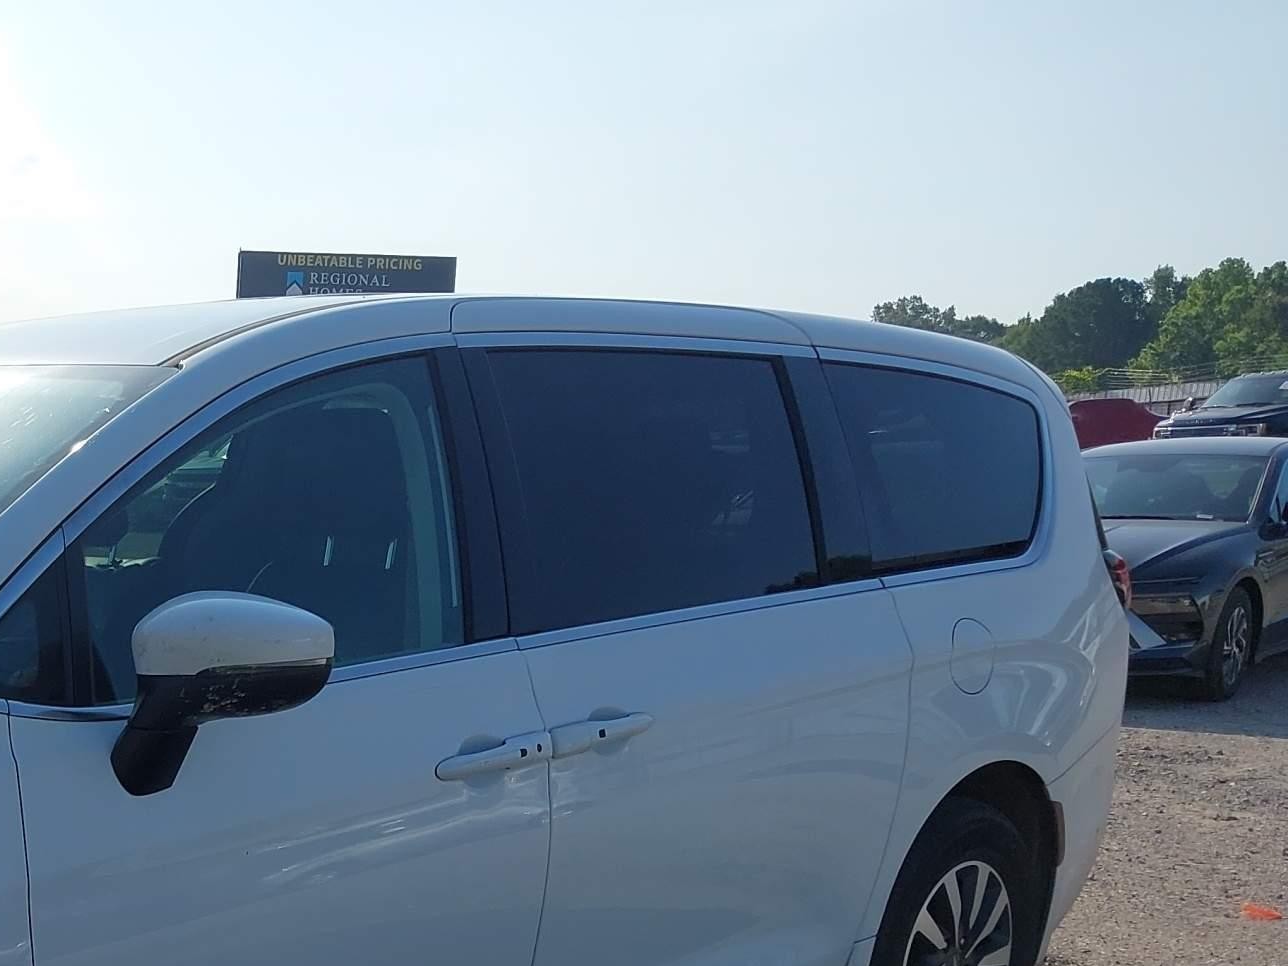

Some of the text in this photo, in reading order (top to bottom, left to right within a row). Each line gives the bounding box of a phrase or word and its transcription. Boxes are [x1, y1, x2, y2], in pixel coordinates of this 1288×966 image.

[278, 254, 423, 271] UNBEATABLE PRICING
[310, 272, 391, 287] REGIONAL
